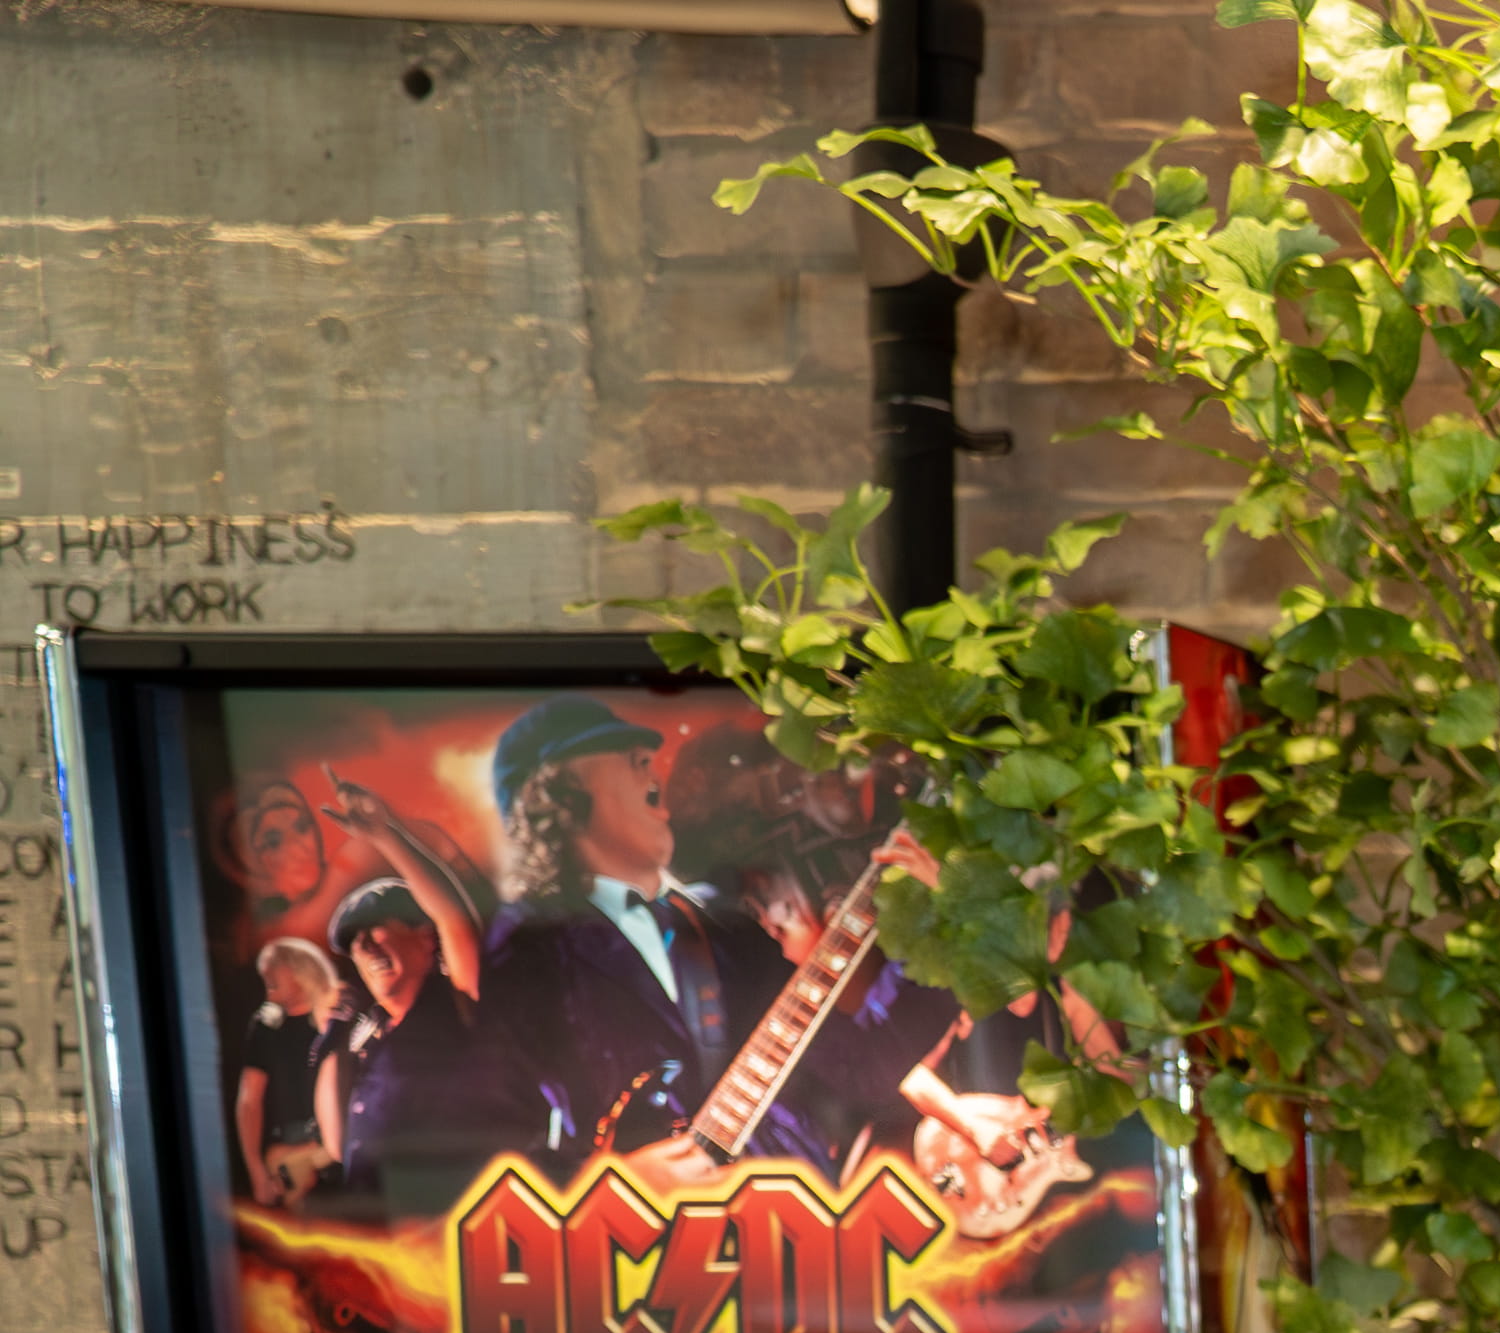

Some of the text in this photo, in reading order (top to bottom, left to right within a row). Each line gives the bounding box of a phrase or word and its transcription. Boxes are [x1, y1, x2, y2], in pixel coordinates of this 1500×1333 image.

[58, 508, 356, 566] HAPPINESS
[31, 578, 265, 625] TO WORK
